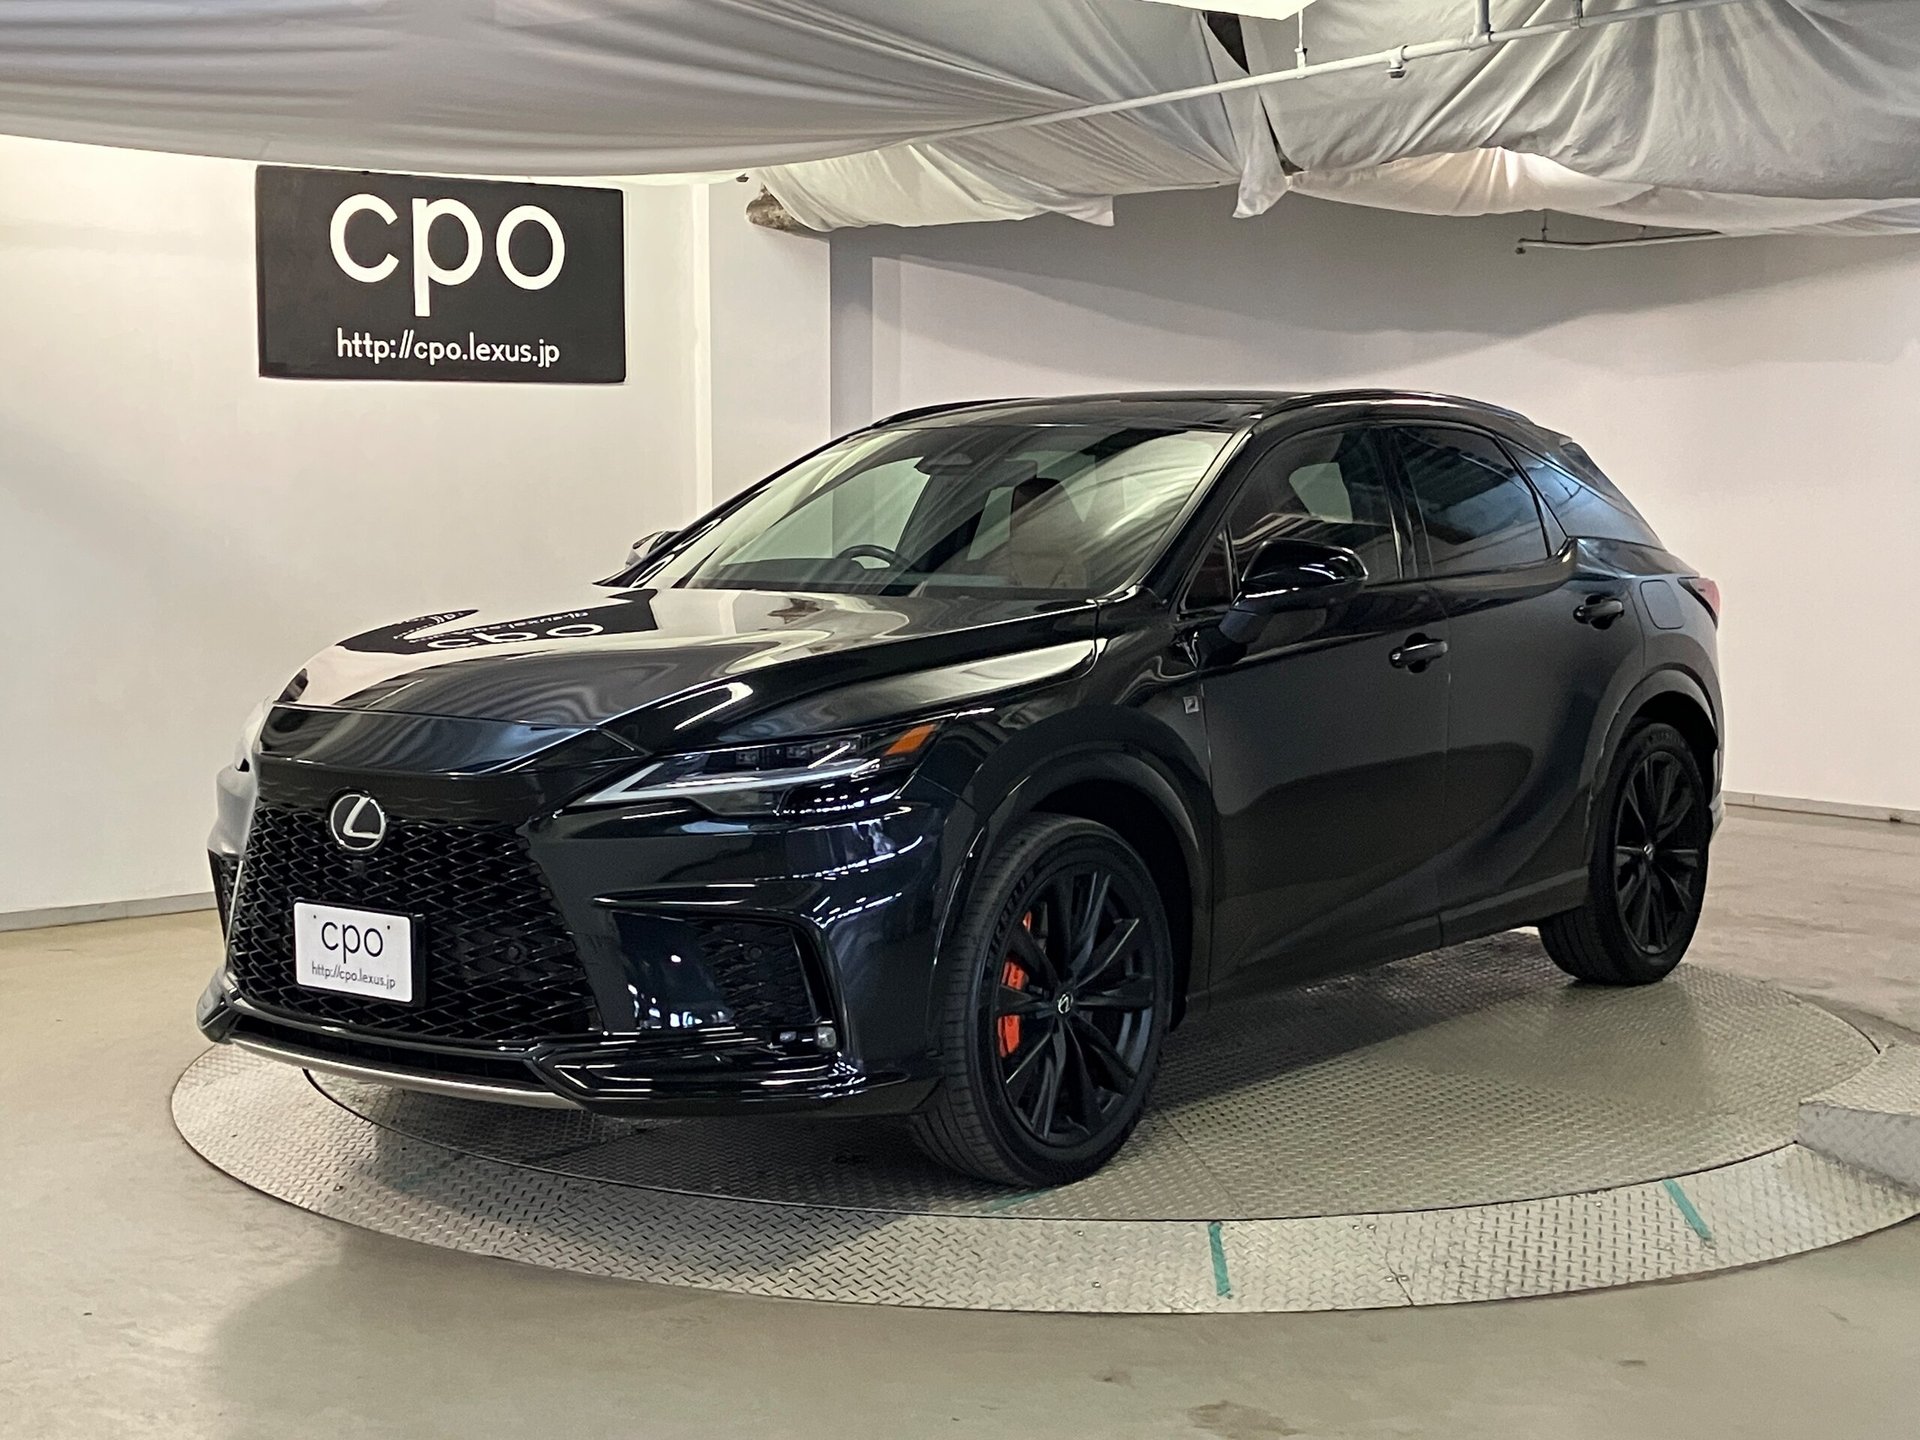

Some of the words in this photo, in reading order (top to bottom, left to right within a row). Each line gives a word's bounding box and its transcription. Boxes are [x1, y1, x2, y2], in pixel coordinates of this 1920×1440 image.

[329, 193, 566, 318] cpo
[336, 326, 561, 368] http://cpo.lexus.jp
[321, 921, 384, 964] cpo
[311, 961, 396, 990] http://cpo.lexus.jp
